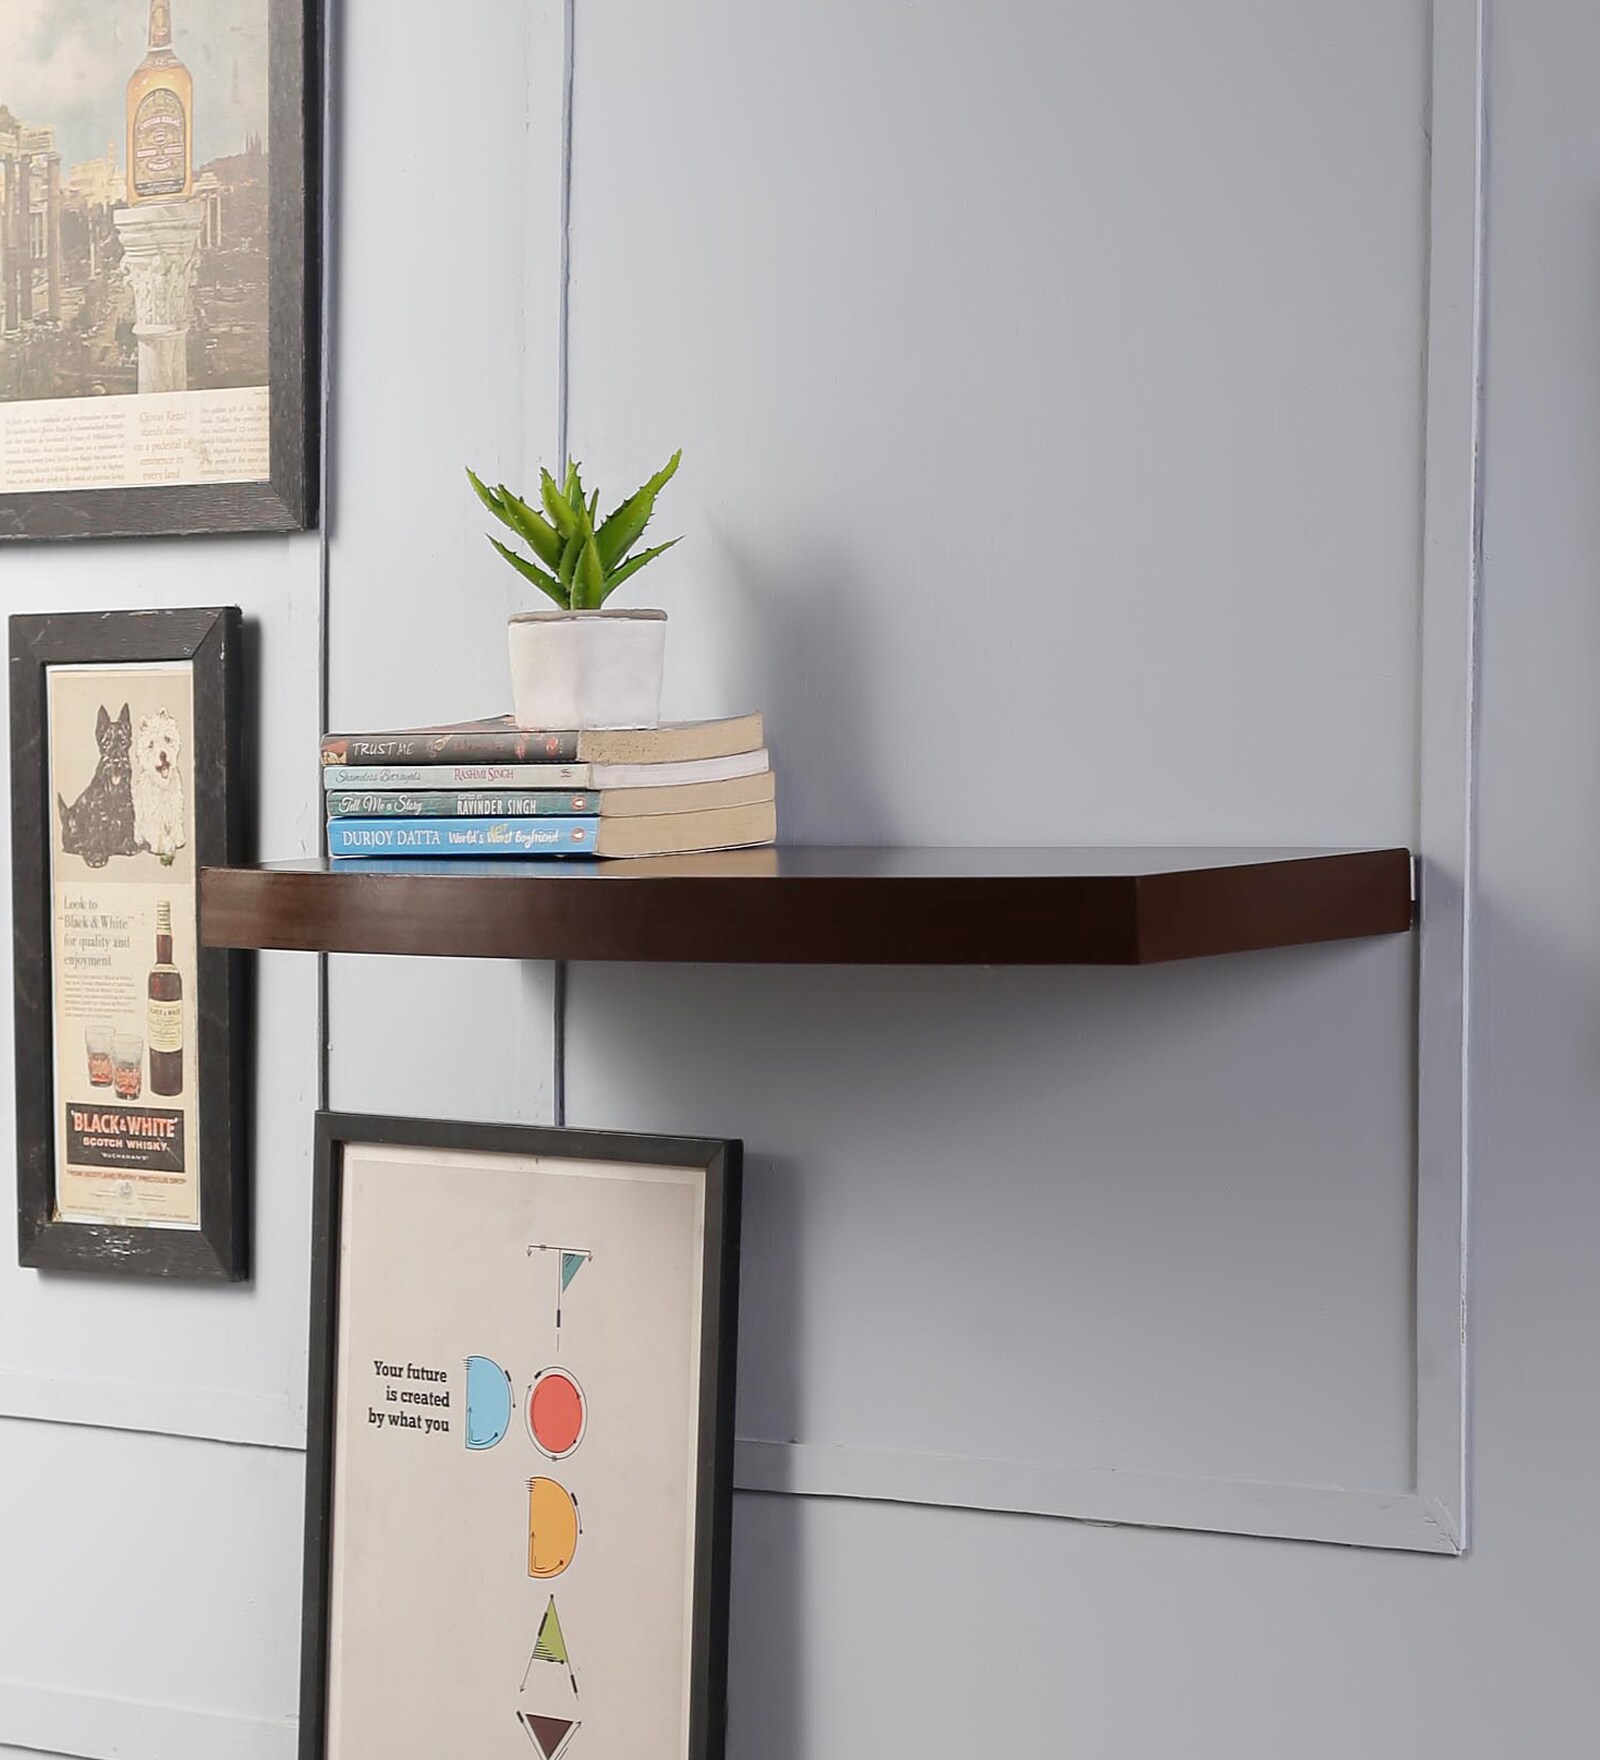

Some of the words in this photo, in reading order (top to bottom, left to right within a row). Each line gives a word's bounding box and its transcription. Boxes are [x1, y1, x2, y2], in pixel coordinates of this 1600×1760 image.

[352, 742, 396, 756] TRUST
[397, 742, 415, 756] ME
[454, 768, 486, 780] RASHMI
[487, 767, 514, 782] SINGH
[338, 797, 361, 813] Tell
[362, 795, 384, 813] Me
[386, 803, 392, 811] a
[394, 794, 424, 816] Story
[457, 800, 503, 815] RAVINDER
[507, 799, 537, 815] SINGH
[343, 830, 393, 847] DURJOY
[397, 830, 441, 845] DATTA
[448, 830, 485, 844] World's
[515, 829, 560, 849] Boyfriend
[64, 895, 86, 910] Look
[88, 899, 98, 910] to
[64, 933, 77, 948] for
[79, 934, 111, 952] quality
[113, 936, 130, 948] and
[64, 952, 112, 970] enjoyment
[82, 1136, 123, 1149] SCOTCH
[126, 1139, 168, 1152] WHISKY
[373, 1360, 404, 1378] Your
[407, 1362, 447, 1383] future
[386, 1385, 397, 1401] is
[400, 1391, 450, 1407] created
[368, 1407, 385, 1428] by
[388, 1410, 422, 1429] what
[425, 1418, 449, 1434] you
